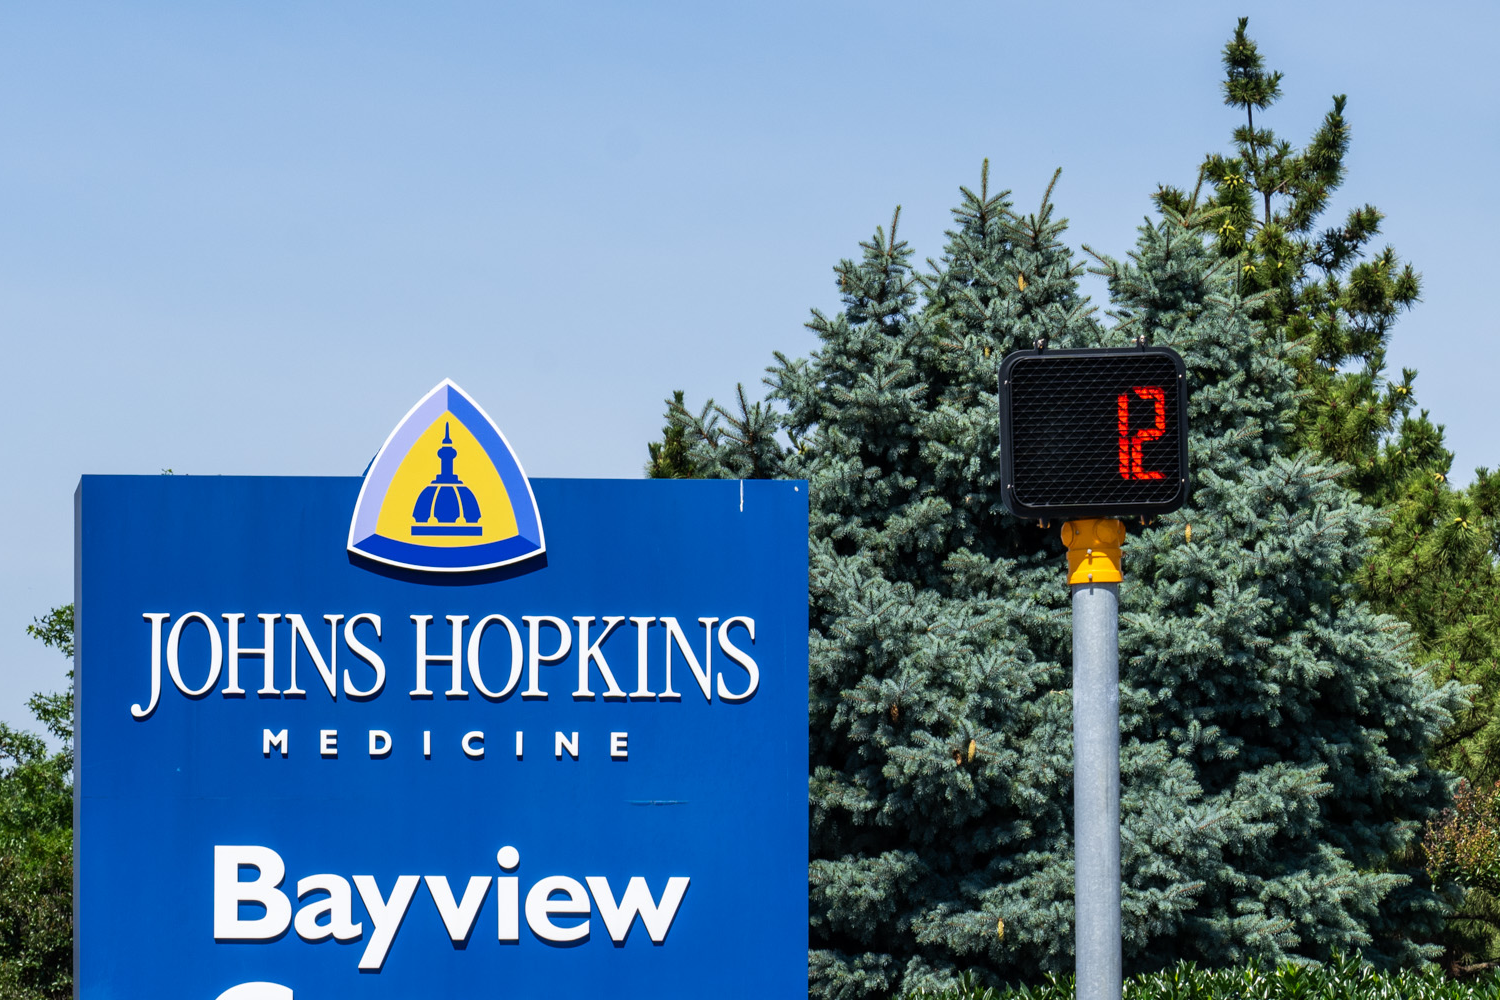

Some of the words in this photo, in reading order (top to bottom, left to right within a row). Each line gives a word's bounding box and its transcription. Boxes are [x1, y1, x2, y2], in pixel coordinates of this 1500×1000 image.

[1117, 385, 1167, 480] 12
[131, 611, 386, 718] JOHNS
[409, 613, 760, 701] HOPKINS
[263, 728, 628, 757] MEDICINE
[213, 845, 691, 969] Bayview
